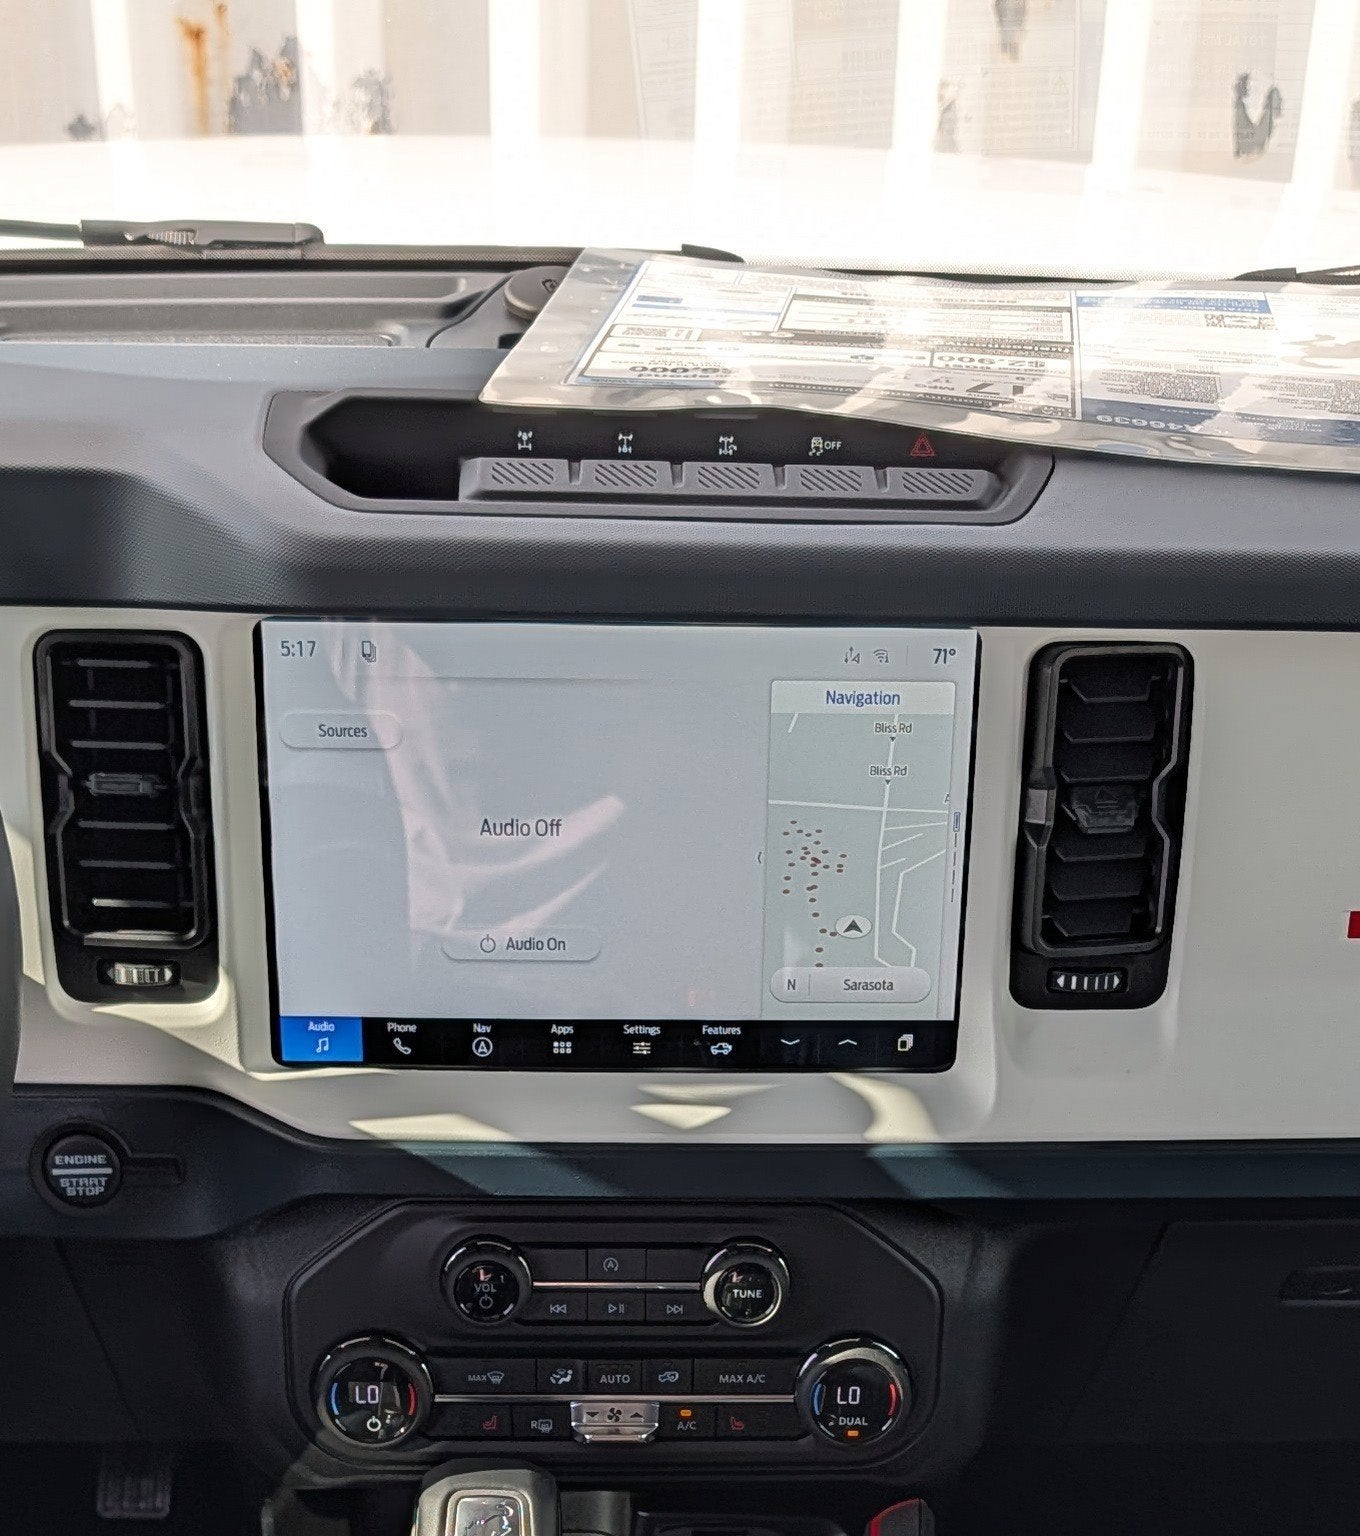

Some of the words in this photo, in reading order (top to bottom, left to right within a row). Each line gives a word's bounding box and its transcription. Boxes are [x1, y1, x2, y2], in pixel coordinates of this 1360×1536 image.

[824, 441, 842, 451] OFF
[280, 640, 316, 658] 5:17
[826, 690, 901, 707] Navigation
[318, 724, 368, 739] Sources
[874, 722, 897, 734] Bliss
[898, 722, 913, 734] Rd
[869, 765, 892, 777] Bliss
[893, 765, 908, 777] Rd
[480, 818, 531, 837] Audio
[535, 818, 562, 837] Off
[505, 937, 544, 952] Audio
[547, 938, 566, 952] On
[787, 979, 796, 991] N
[843, 979, 894, 992] Sarasota
[307, 1021, 335, 1032] Audio
[387, 1022, 417, 1033] Phone
[473, 1023, 492, 1033] Nav
[551, 1023, 574, 1036] Apps
[623, 1023, 661, 1036] Settings
[702, 1024, 741, 1035] Features
[54, 1154, 107, 1165] ENGINE
[60, 1177, 108, 1188] START
[66, 1186, 104, 1197] STOP
[473, 1283, 497, 1293] VOL
[733, 1289, 762, 1299] TUNE
[467, 1374, 487, 1382] MAX
[600, 1374, 631, 1384] AUTO
[719, 1374, 743, 1384] MAX
[746, 1374, 766, 1384] A/C
[355, 1384, 379, 1404] LO
[836, 1386, 861, 1405] LO
[677, 1420, 697, 1431] A/C
[839, 1416, 868, 1426] DUAL
